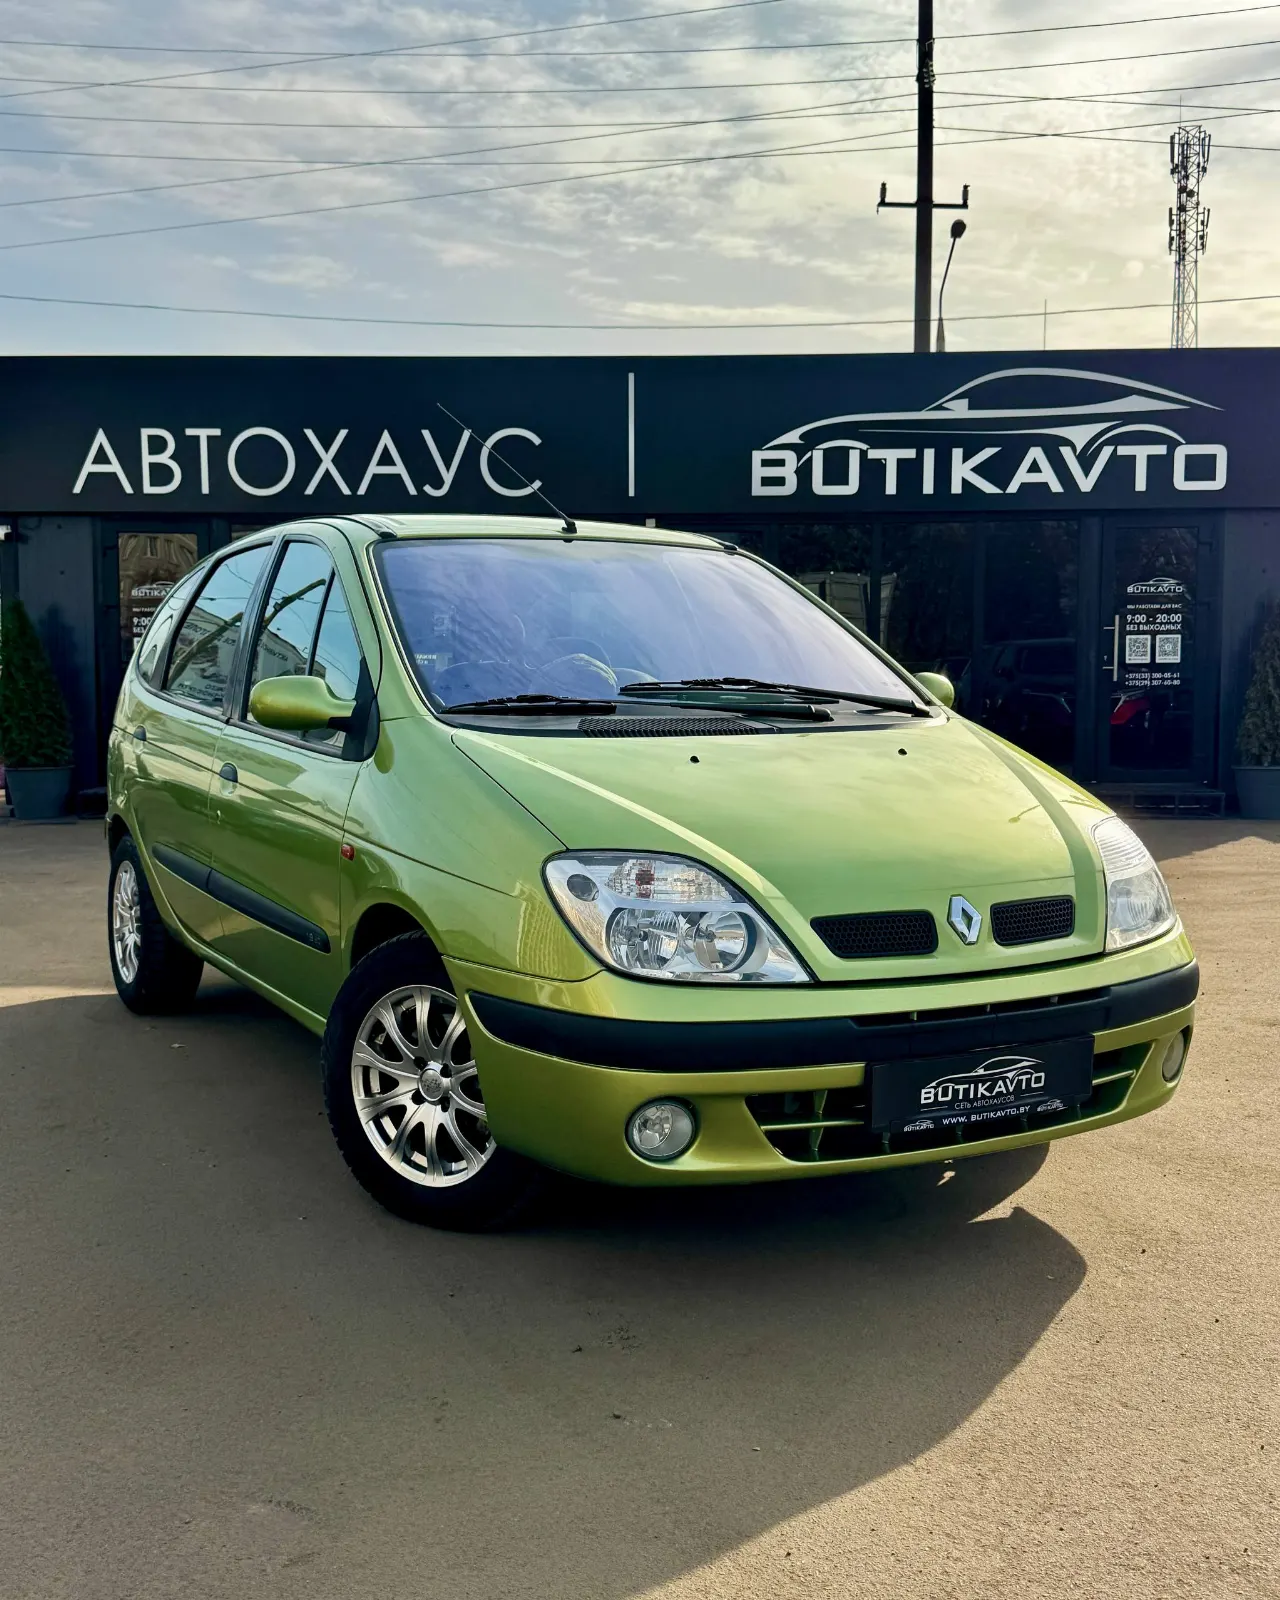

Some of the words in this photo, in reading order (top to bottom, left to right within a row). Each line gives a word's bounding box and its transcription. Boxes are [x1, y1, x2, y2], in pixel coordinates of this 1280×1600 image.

[72, 426, 543, 497] АВТОХАУС
[751, 443, 1228, 497] BUTIKAVTO
[1126, 585, 1183, 593] BUTIKAVTO
[1126, 614, 1147, 623] 9:00
[1156, 613, 1182, 623] 20:00
[1139, 623, 1181, 631] ВЫХОДНЫХ
[920, 1071, 1045, 1104] BUTIKAVTO
[972, 1094, 1015, 1108] АВТОХАУСОВ
